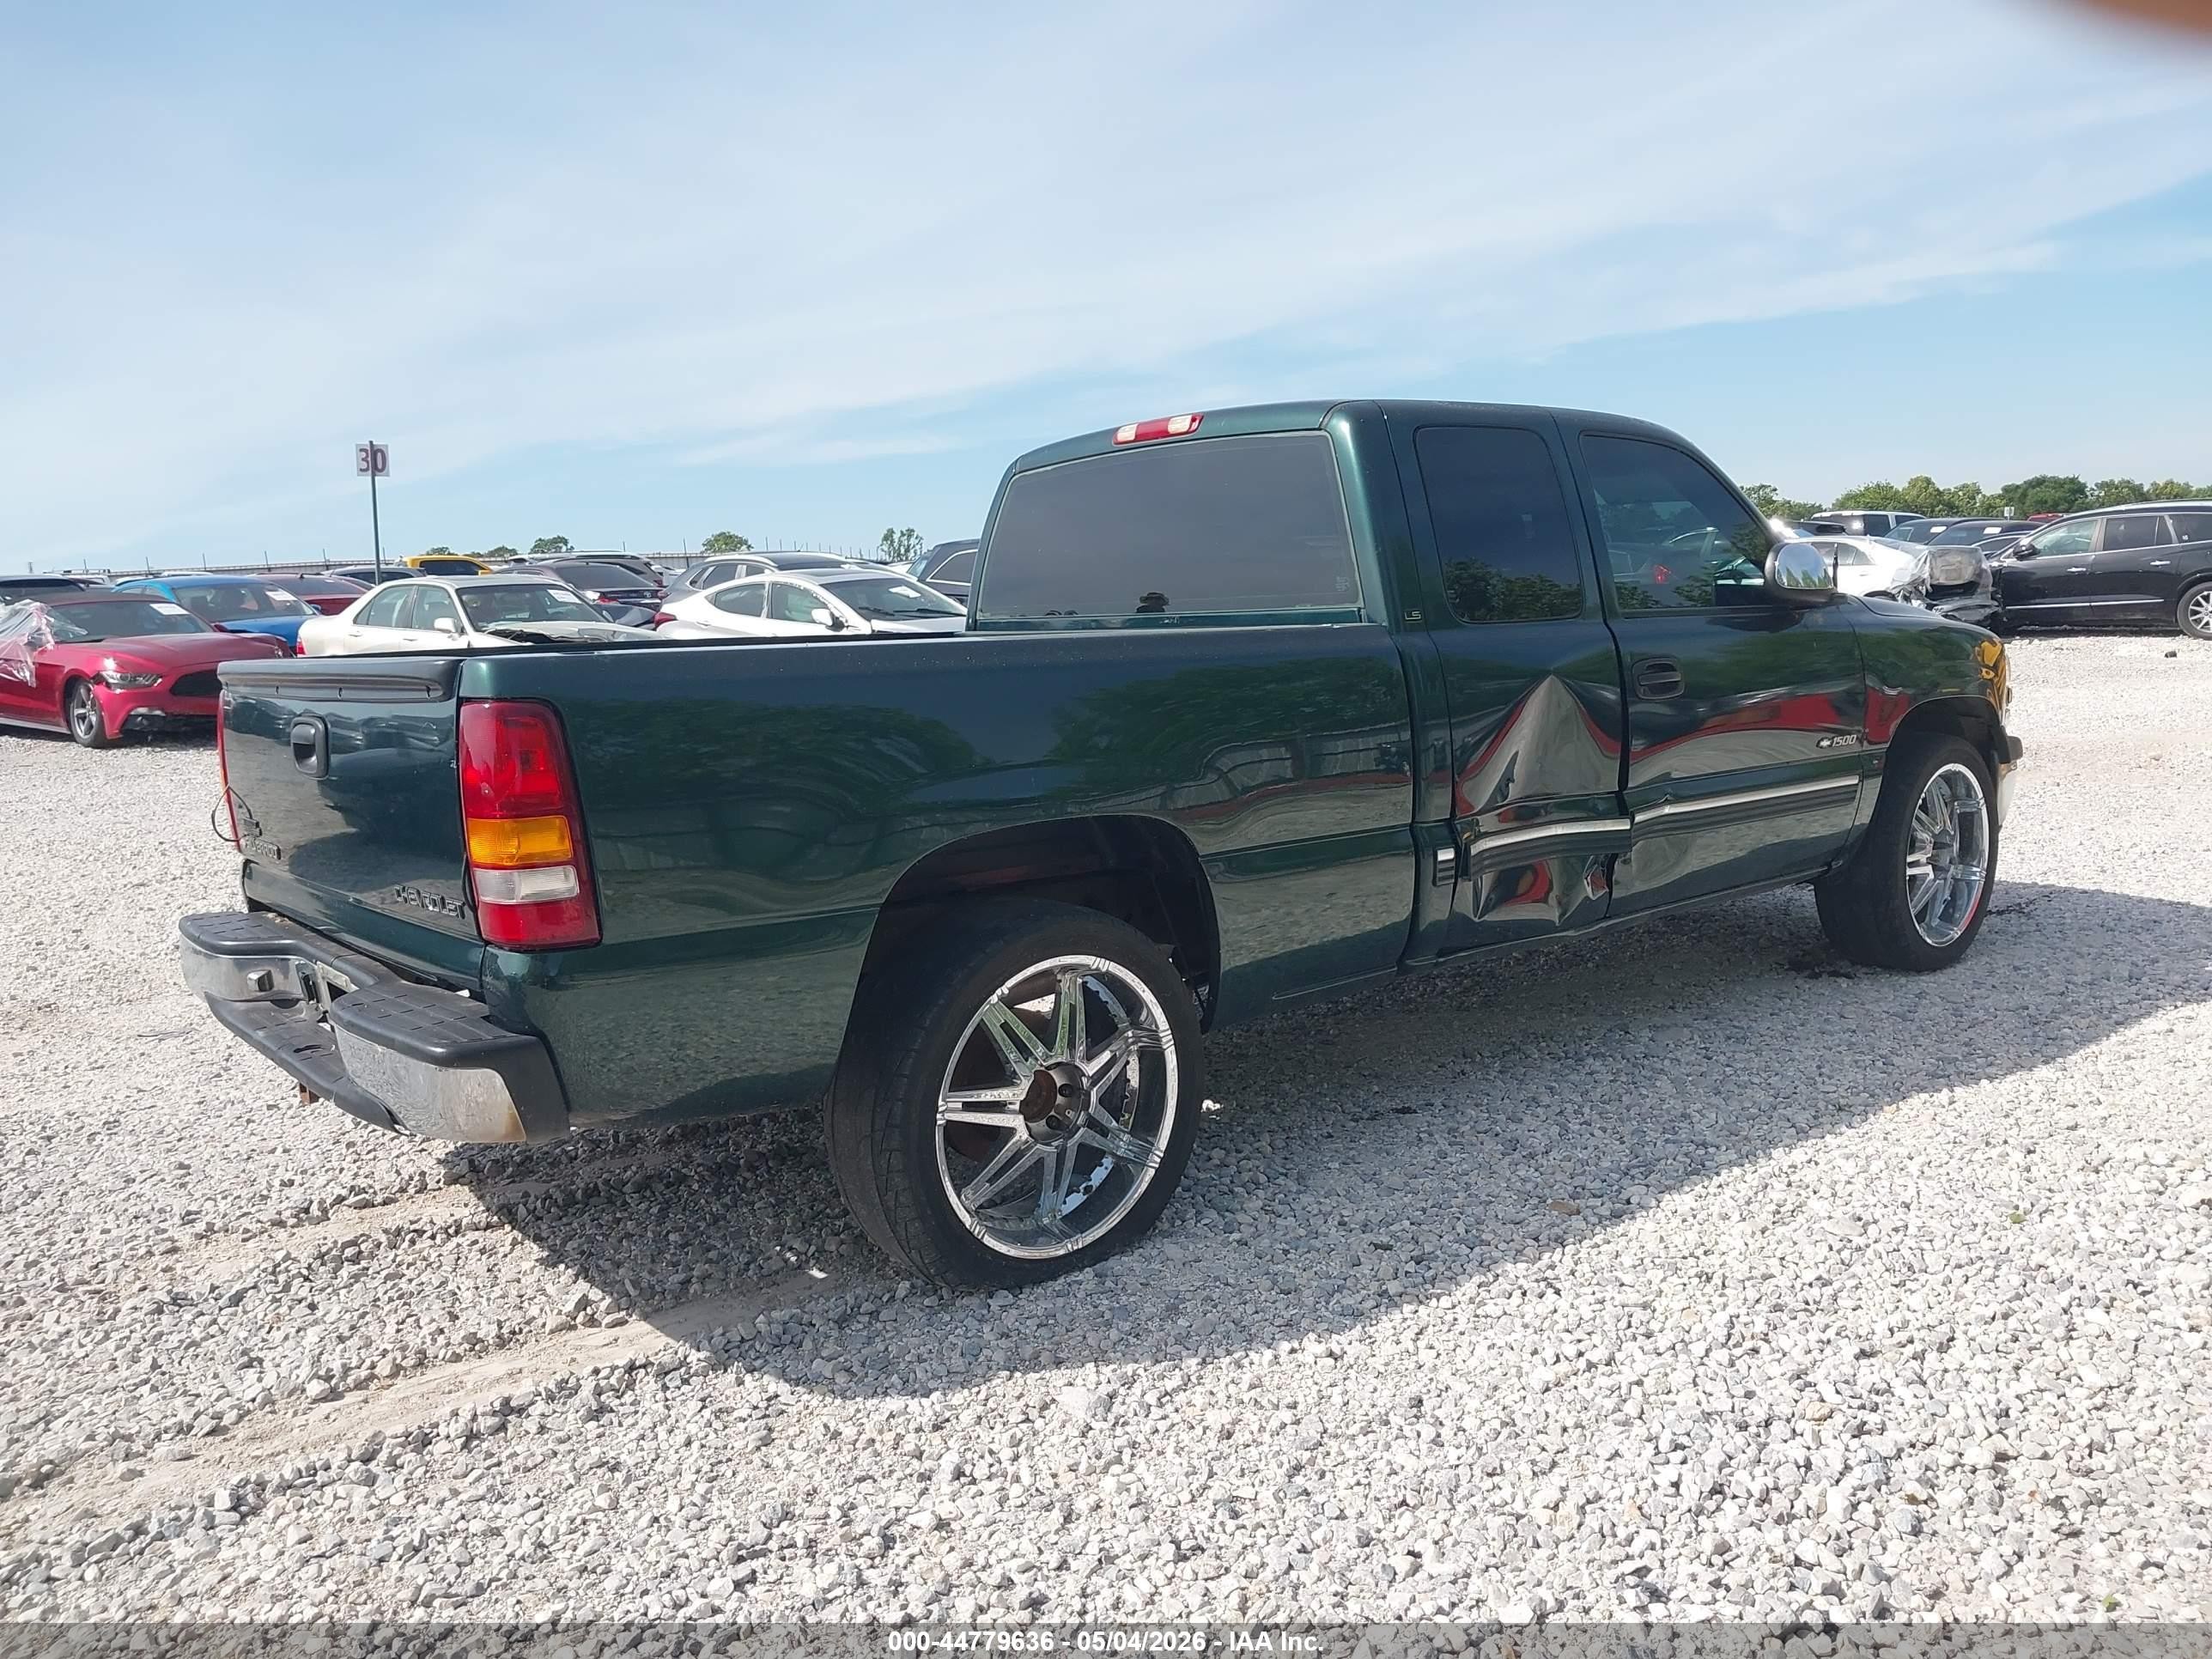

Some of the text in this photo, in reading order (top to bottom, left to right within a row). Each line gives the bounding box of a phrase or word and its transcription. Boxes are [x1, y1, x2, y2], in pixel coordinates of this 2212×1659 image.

[359, 447, 386, 473] 30
[1404, 611, 1422, 621] LS
[1832, 734, 1858, 748] 1500
[394, 884, 465, 920] CHEVROLET
